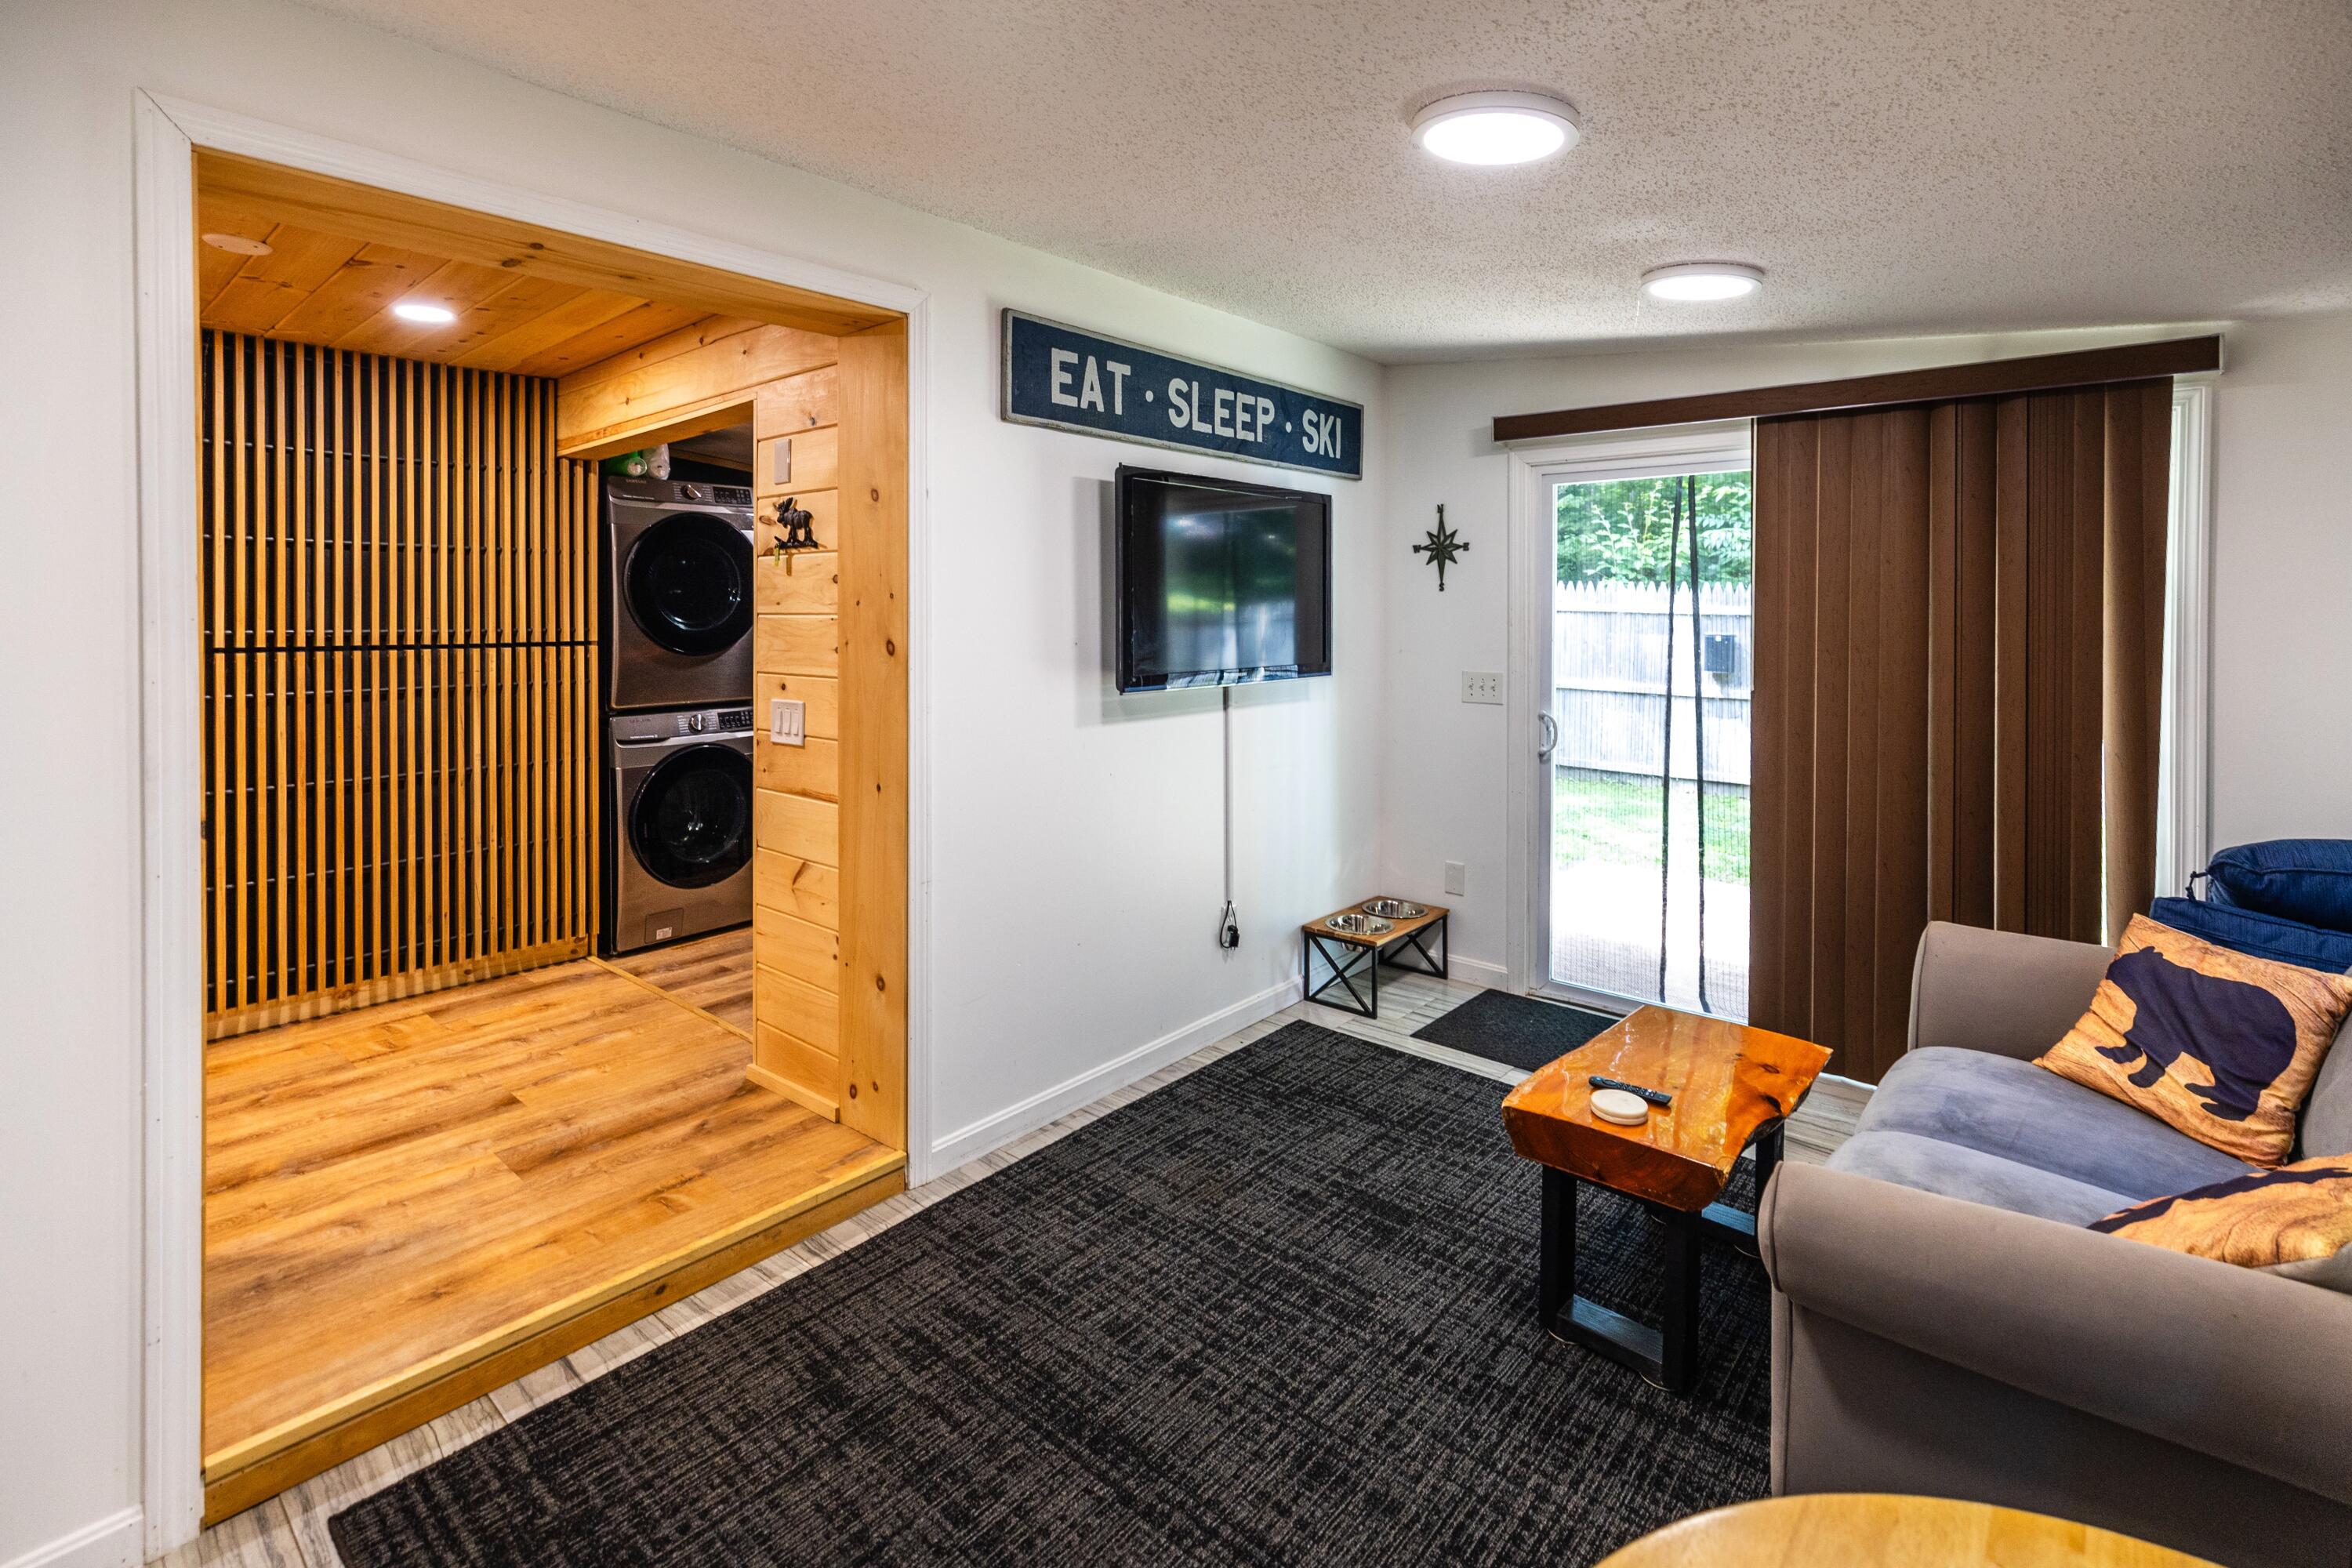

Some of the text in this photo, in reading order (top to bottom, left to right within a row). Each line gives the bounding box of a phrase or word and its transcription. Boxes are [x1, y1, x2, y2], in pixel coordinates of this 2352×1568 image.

[1051, 347, 1341, 459] EAT SLEEP SKI
